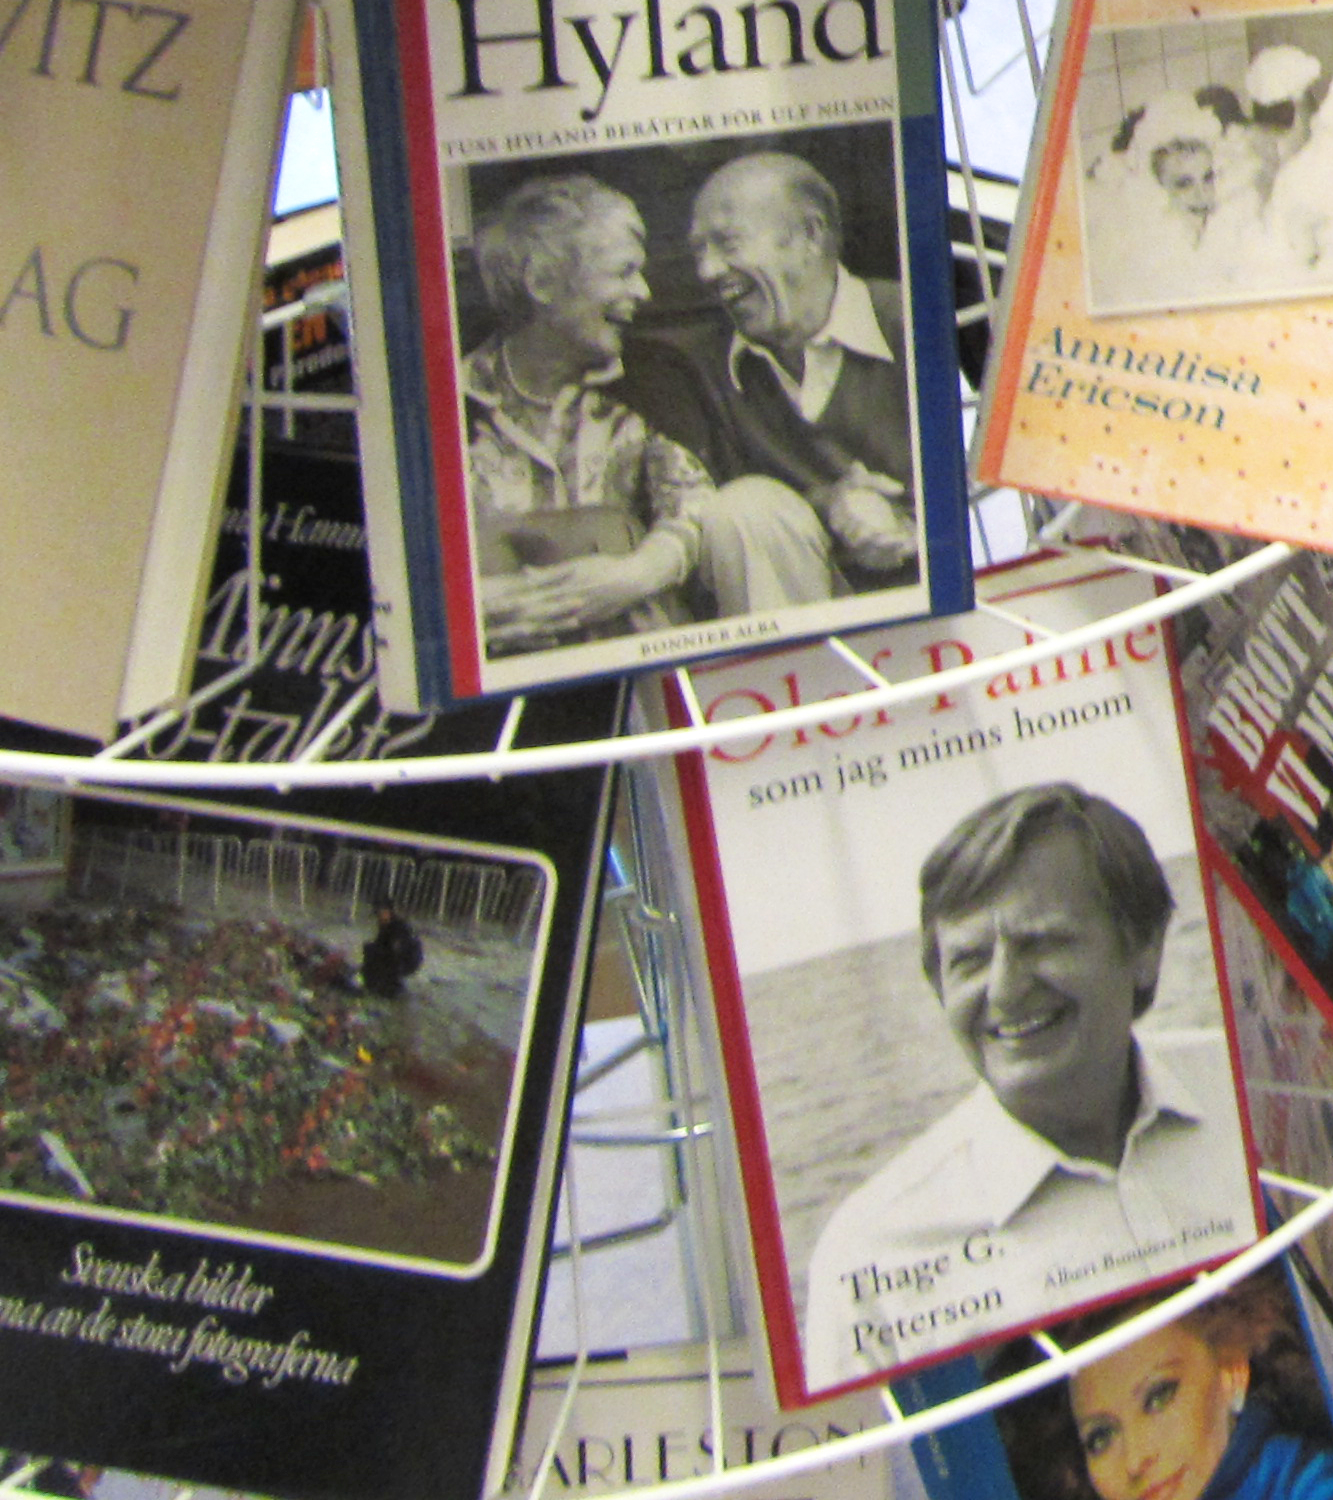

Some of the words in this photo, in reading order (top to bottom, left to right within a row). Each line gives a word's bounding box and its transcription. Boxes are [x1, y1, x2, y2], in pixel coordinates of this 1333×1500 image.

[504, 129, 600, 153] HYLAND
[604, 116, 716, 143] BERÄTTAR
[723, 109, 766, 131] FÖR
[1022, 364, 1231, 433] Ericson
[1029, 326, 1265, 399] Annalisa
[639, 631, 732, 658] BONNIER
[737, 619, 782, 644] ALBA
[1207, 573, 1330, 775] BROTT
[748, 773, 824, 809] som
[836, 752, 888, 793] jag
[898, 726, 1003, 773] minns
[1012, 690, 1134, 740] honom
[1264, 741, 1332, 834] VI
[61, 1241, 186, 1301] Svenska
[185, 1258, 274, 1315] bilder
[840, 1246, 953, 1309] Thage
[963, 1228, 1005, 1267] G.
[1043, 1260, 1099, 1291] Albert
[1102, 1238, 1177, 1273] Bonniers
[1181, 1216, 1236, 1255] Förlag
[114, 1313, 188, 1356] stora
[169, 1314, 359, 1389] fotograferna
[852, 1285, 1004, 1355] Peterson
[503, 1421, 868, 1491] ARLESTON
